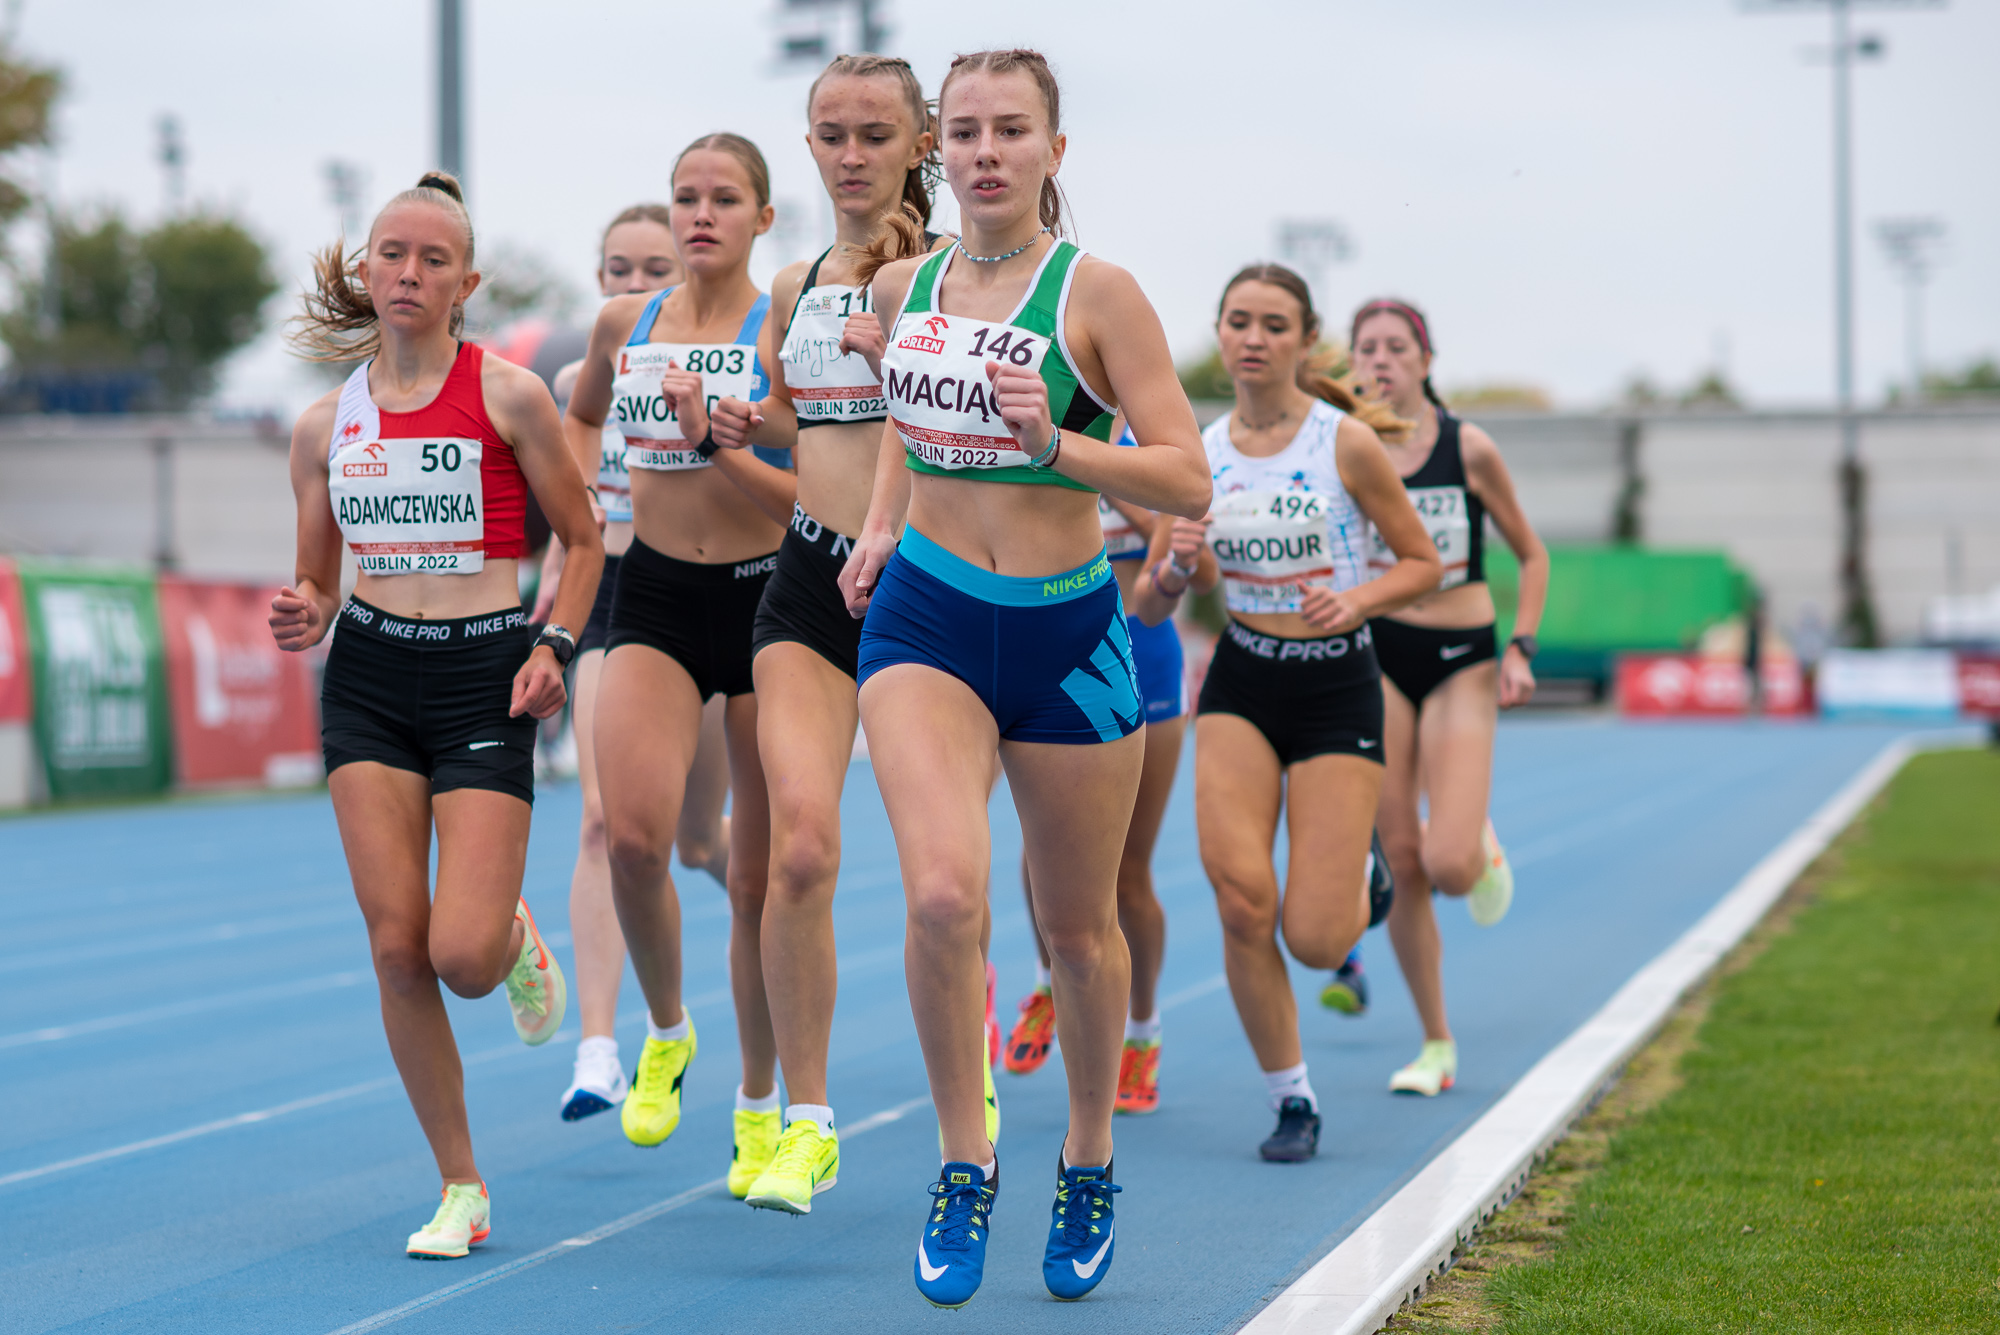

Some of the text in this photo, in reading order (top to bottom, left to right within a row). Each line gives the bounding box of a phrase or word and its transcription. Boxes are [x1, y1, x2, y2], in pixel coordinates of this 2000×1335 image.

[838, 290, 877, 318] 11
[900, 336, 944, 353] ORLEN
[968, 328, 1037, 366] 146
[686, 349, 745, 375] 803
[804, 398, 889, 415] LUBLIN 2022
[929, 436, 958, 446] JANUSZA
[956, 434, 981, 442] POLSKI
[421, 443, 462, 472] 50
[641, 450, 683, 465] LUBLIN
[950, 449, 998, 466] 2022
[344, 464, 386, 476] ORLEN
[339, 493, 477, 525] ADAMCZEWSKA
[1270, 495, 1320, 520] 496
[1213, 534, 1323, 562] CHODUR
[361, 555, 458, 570] LUBLIN 2022
[734, 556, 778, 579] NIKE
[1043, 572, 1088, 597] NIKE
[346, 603, 374, 625] PRO
[379, 618, 451, 641] NIKE PRO
[464, 616, 503, 638] NIKE
[1228, 622, 1349, 662] NIKE PRO
[952, 1174, 969, 1183] NIKE
